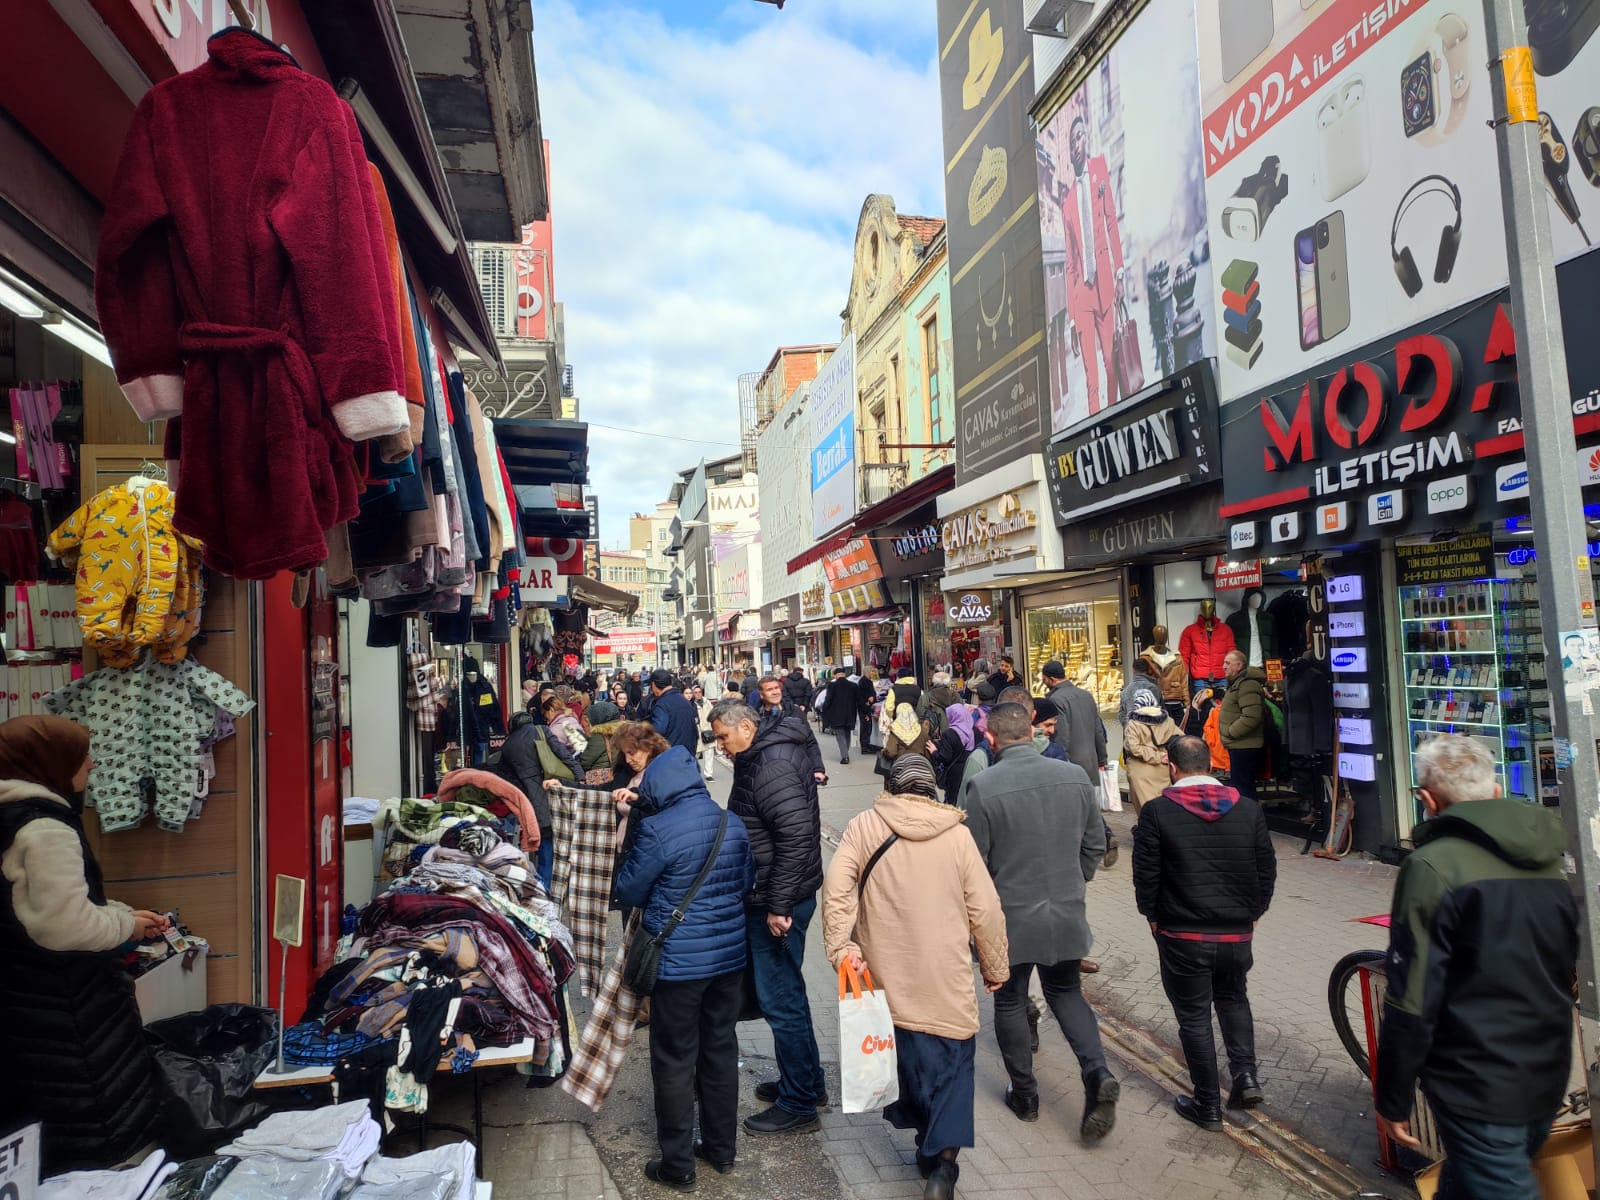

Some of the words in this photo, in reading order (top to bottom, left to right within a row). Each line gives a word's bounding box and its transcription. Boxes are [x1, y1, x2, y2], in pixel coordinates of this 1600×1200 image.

[1209, 53, 1311, 165] MODA
[1260, 302, 1518, 472] MODA
[964, 400, 1000, 445] ÇAVAŞ
[816, 427, 847, 484] Berrak
[1058, 451, 1076, 479] BY
[1076, 408, 1176, 491] GÜWEN
[1315, 431, 1464, 496] İLETİŞİM
[711, 492, 756, 511] İMAJ
[1430, 485, 1465, 503] oppo
[942, 508, 984, 551] ÇAVAŞ
[1102, 511, 1176, 553] GÜWEN
[1228, 574, 1260, 587] KATTADIR
[1339, 583, 1350, 593] LG
[949, 604, 992, 619] ÇAVAŞ
[1336, 621, 1354, 630] iPhone
